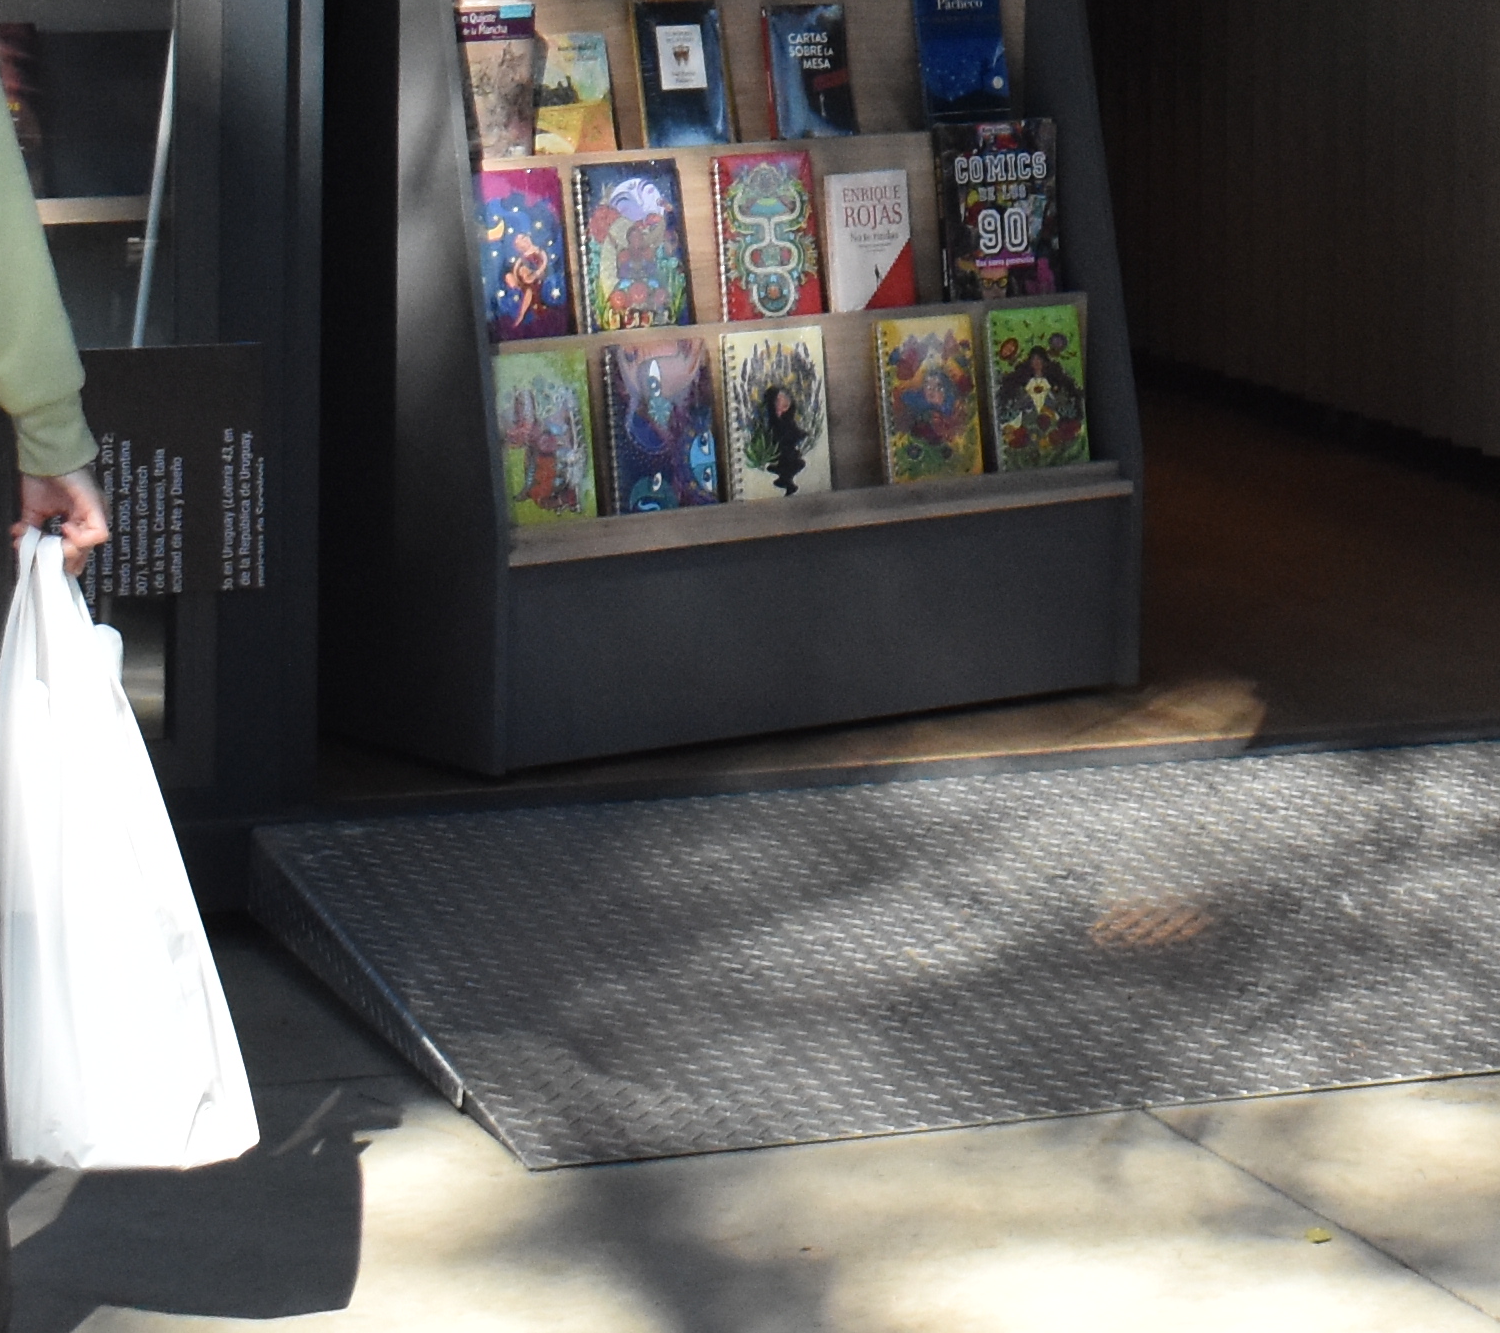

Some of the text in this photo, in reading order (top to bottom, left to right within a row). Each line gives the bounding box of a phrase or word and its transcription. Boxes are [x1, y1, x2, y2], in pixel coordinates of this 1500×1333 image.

[787, 31, 829, 44] CARTAS
[788, 45, 823, 57] SOBRE
[802, 57, 831, 70] MESA
[842, 184, 901, 204] ENRIQUE
[844, 202, 903, 230] ROJAS
[977, 207, 1029, 254] 90
[223, 428, 233, 443] en
[119, 440, 133, 495] Argentina
[153, 448, 165, 477] Italia
[239, 482, 250, 497] de
[171, 508, 182, 532] Arte
[238, 499, 252, 556] República
[171, 533, 182, 549] de
[222, 511, 236, 559] Uruguay
[239, 558, 250, 569] la
[171, 551, 183, 593] acultad
[239, 571, 251, 586] de
[102, 578, 113, 593] de
[154, 574, 165, 589] de
